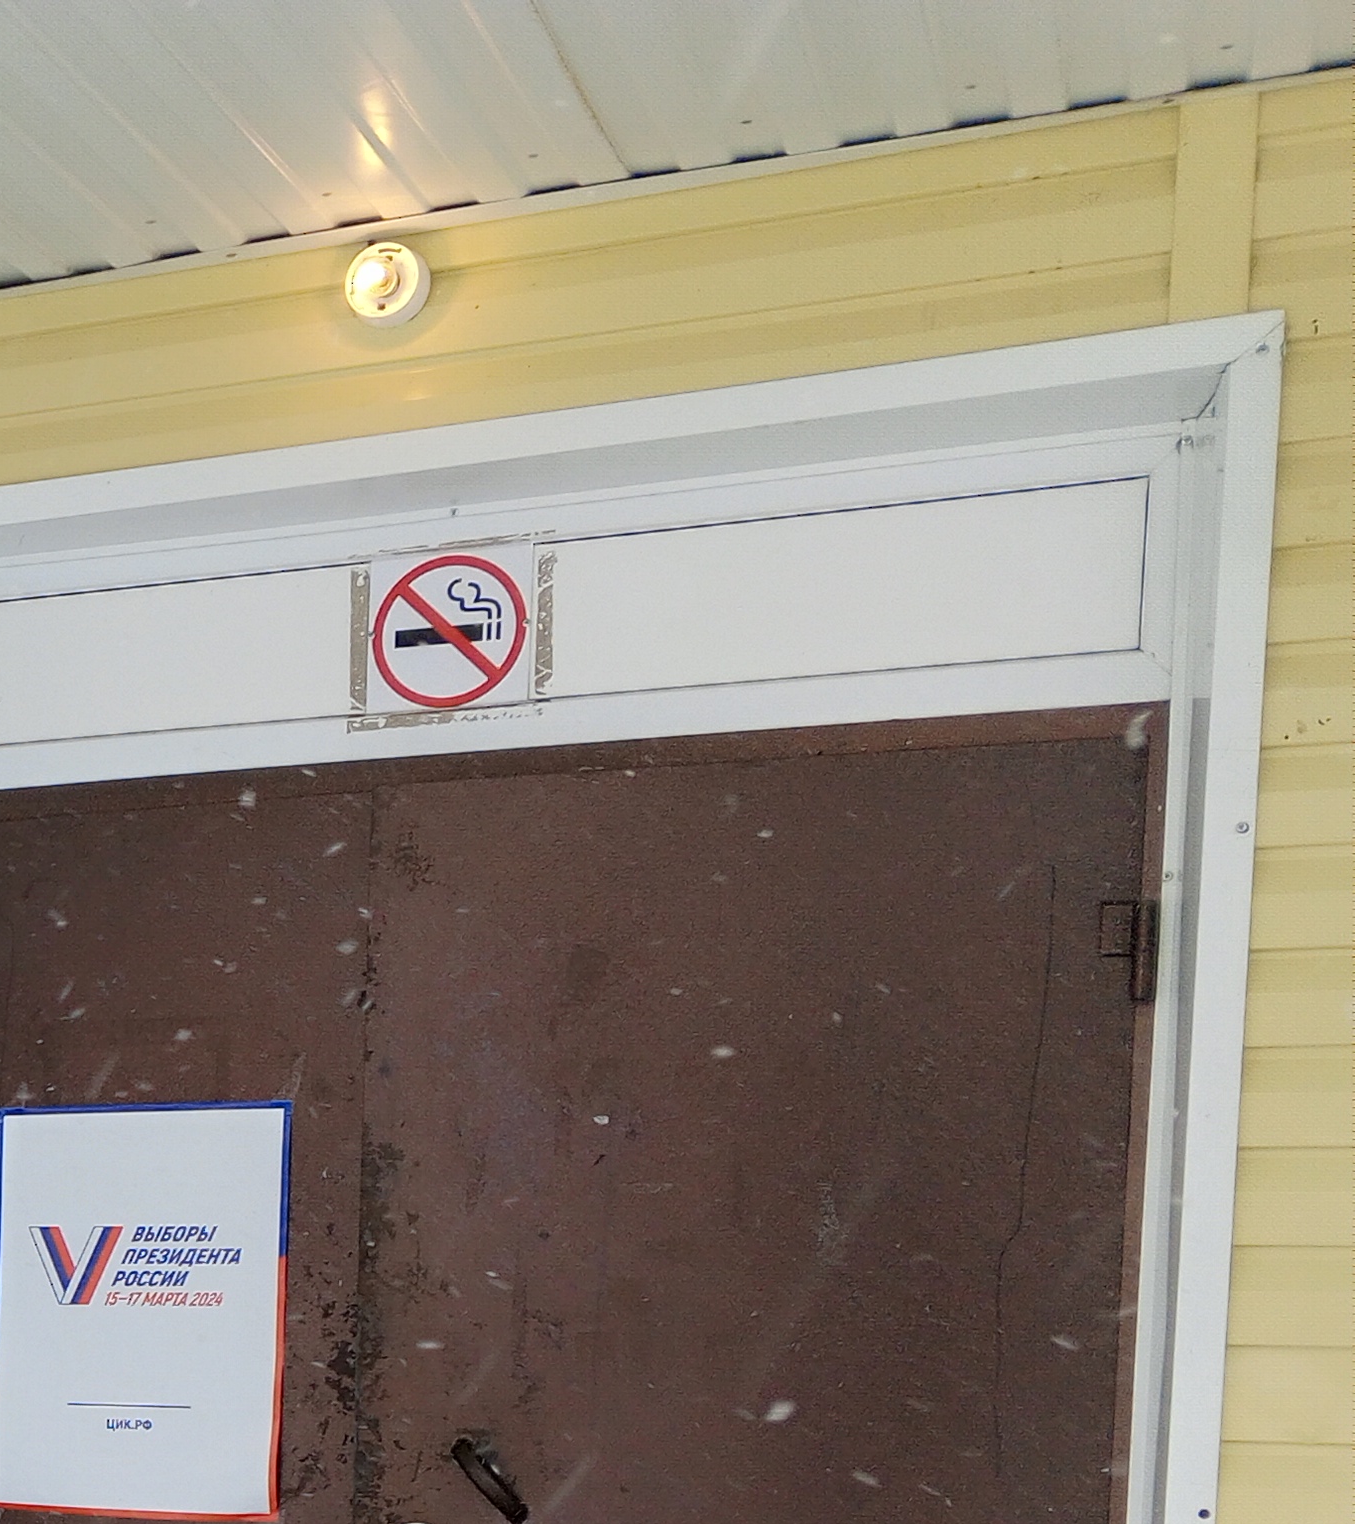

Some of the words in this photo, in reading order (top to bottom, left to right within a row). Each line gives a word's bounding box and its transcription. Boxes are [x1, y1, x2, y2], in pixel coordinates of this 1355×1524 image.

[131, 1225, 218, 1243] ВЫБОРЫ
[121, 1247, 242, 1267] ПРЕЗИДЕНТА
[111, 1271, 190, 1287] РОССИИ
[141, 1292, 188, 1307] МАРТА
[189, 1292, 224, 1307] 2024
[106, 1418, 153, 1432] ЦИК.РФ
